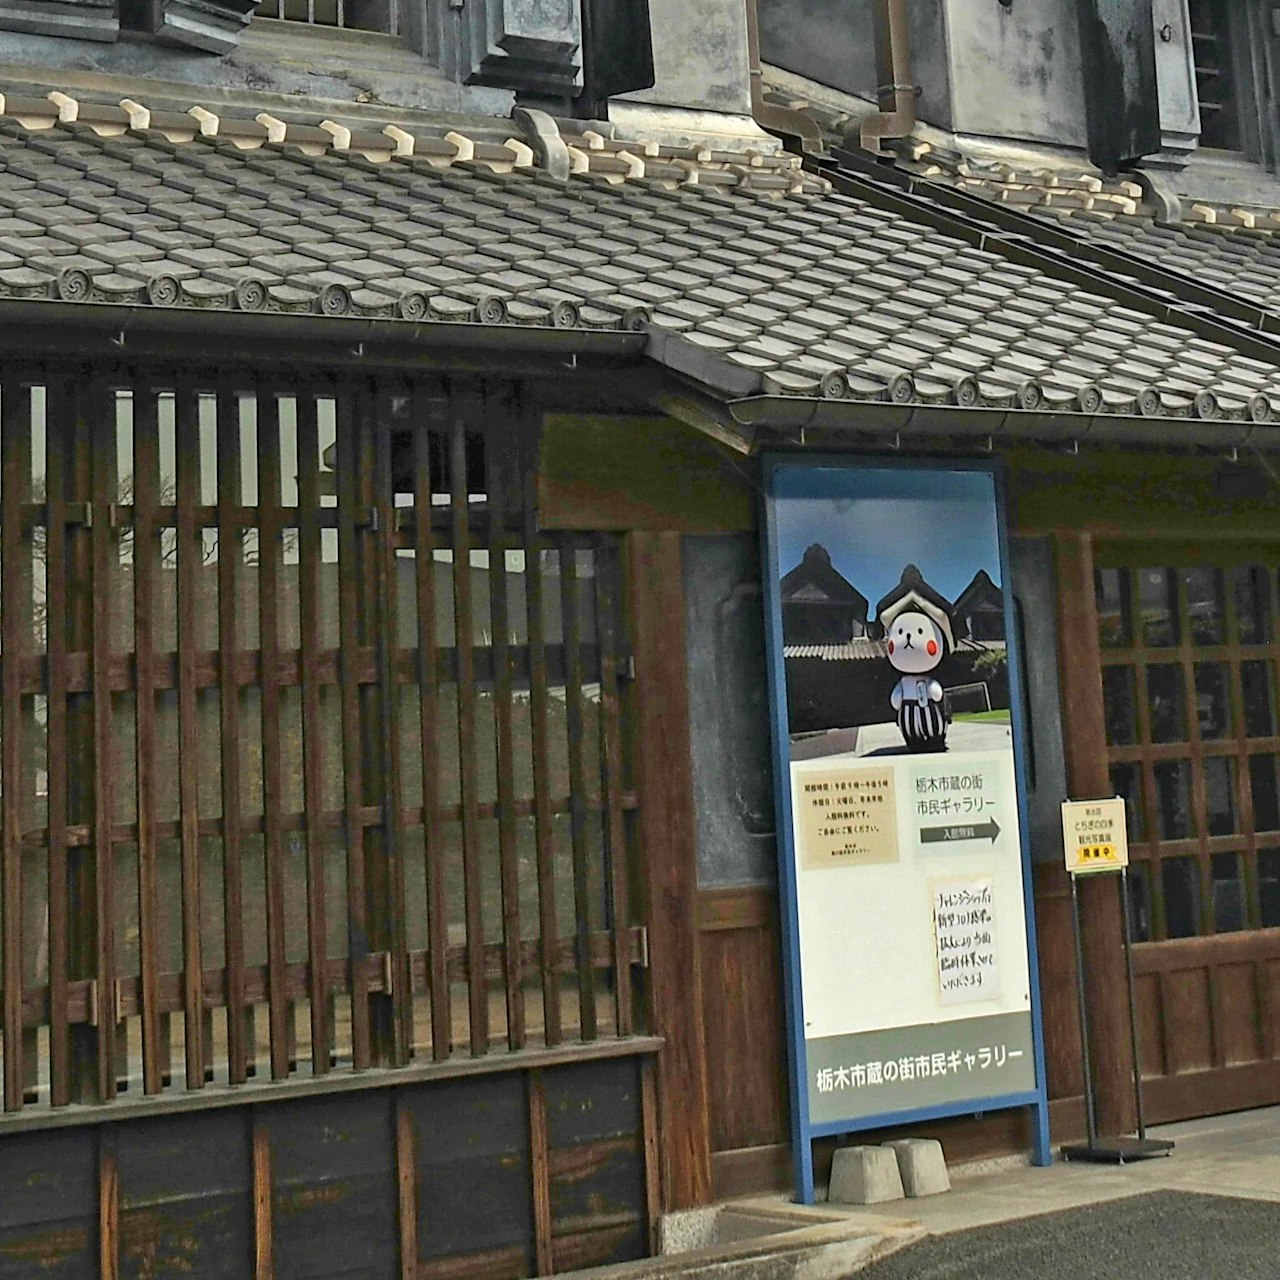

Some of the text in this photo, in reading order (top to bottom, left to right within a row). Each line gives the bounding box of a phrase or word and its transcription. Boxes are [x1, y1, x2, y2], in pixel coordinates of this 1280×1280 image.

[916, 774, 983, 793] 栃木市蔵の街
[917, 798, 996, 815] 市民ギャラリー
[816, 1045, 1023, 1093] 栃木市蔵の街市民ギャラリー
